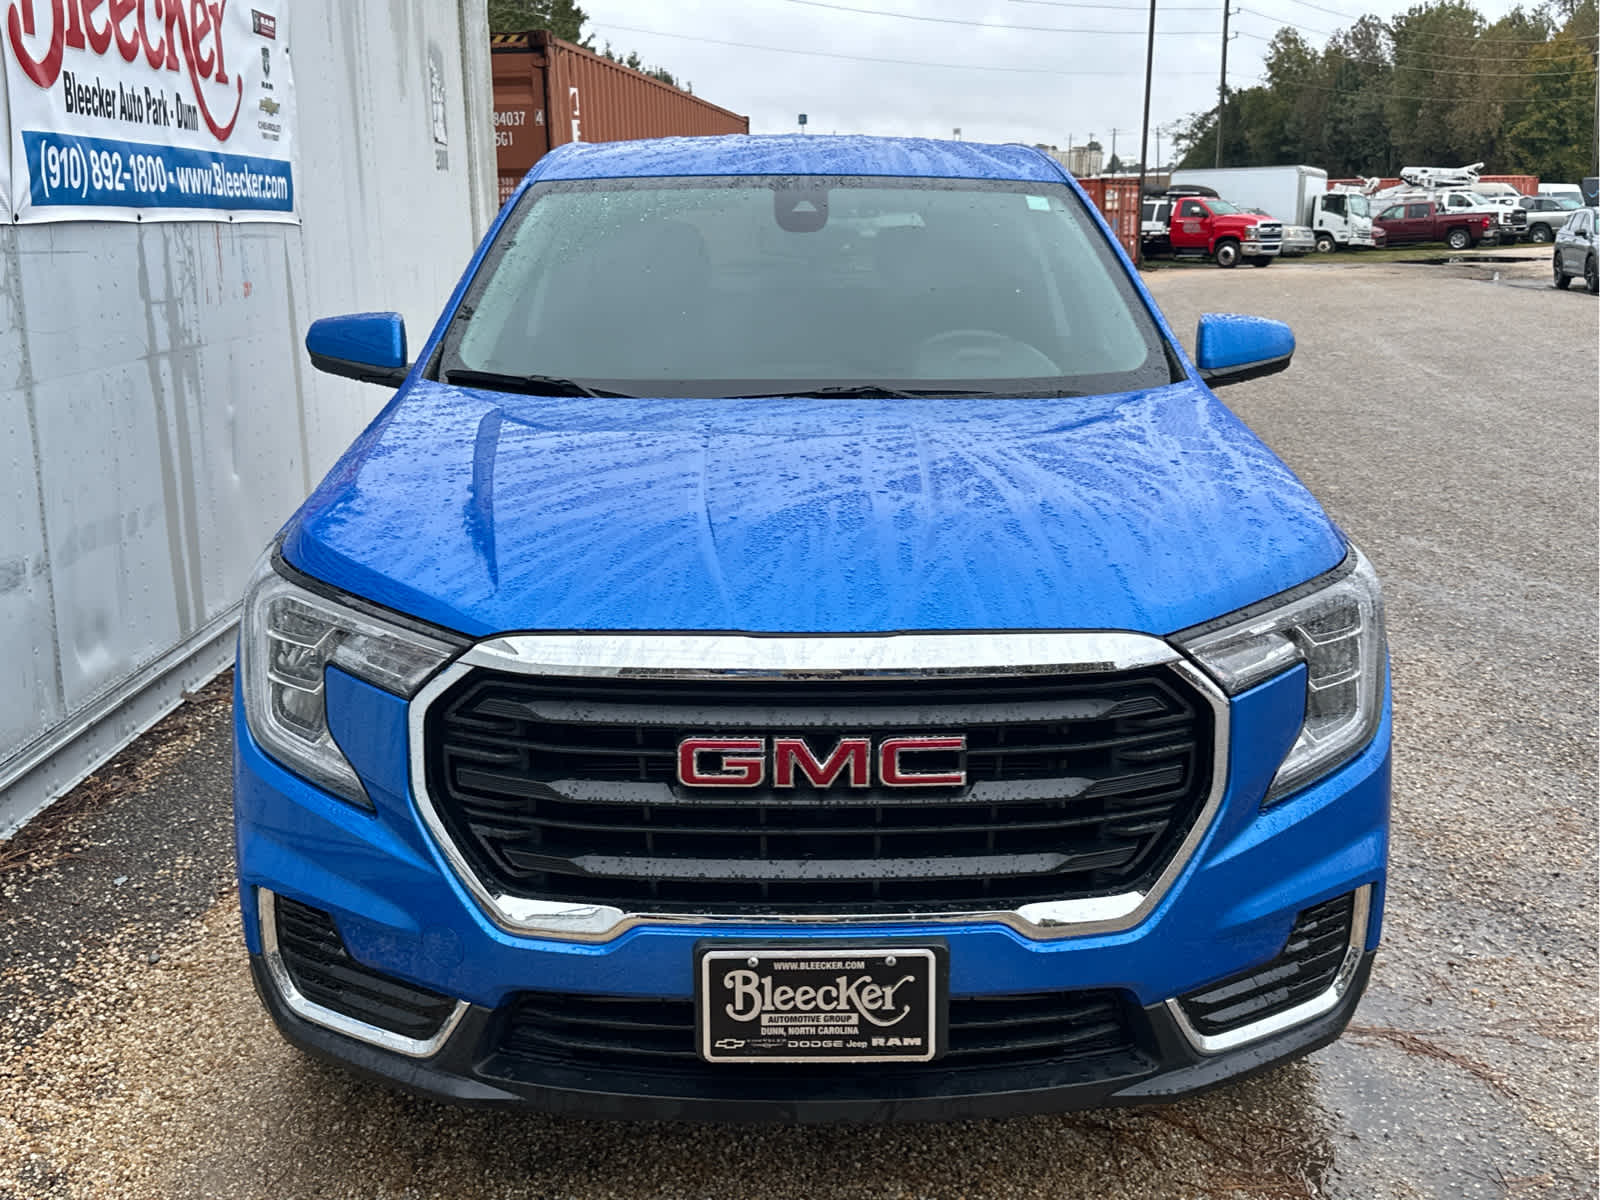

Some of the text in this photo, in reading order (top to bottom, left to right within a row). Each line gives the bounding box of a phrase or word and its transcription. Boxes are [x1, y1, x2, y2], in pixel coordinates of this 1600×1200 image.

[63, 70, 116, 119] Bleecker
[119, 81, 143, 123] Auto
[144, 86, 170, 127] Park
[176, 92, 199, 131] Dunn
[41, 140, 88, 198] (910)
[90, 151, 166, 193] 892-1800
[176, 162, 288, 200] www.Bleecker.com
[678, 736, 966, 787] GMC
[773, 961, 865, 970] WWW.BLEECKER.COM
[768, 1014, 852, 1024] AUTOMOTIVE GROUP
[761, 1026, 859, 1036] DUNN, NORTH CAROLINA
[788, 1040, 843, 1048] DODGE
[846, 1039, 868, 1048] Jeep
[872, 1037, 921, 1047] RAM
